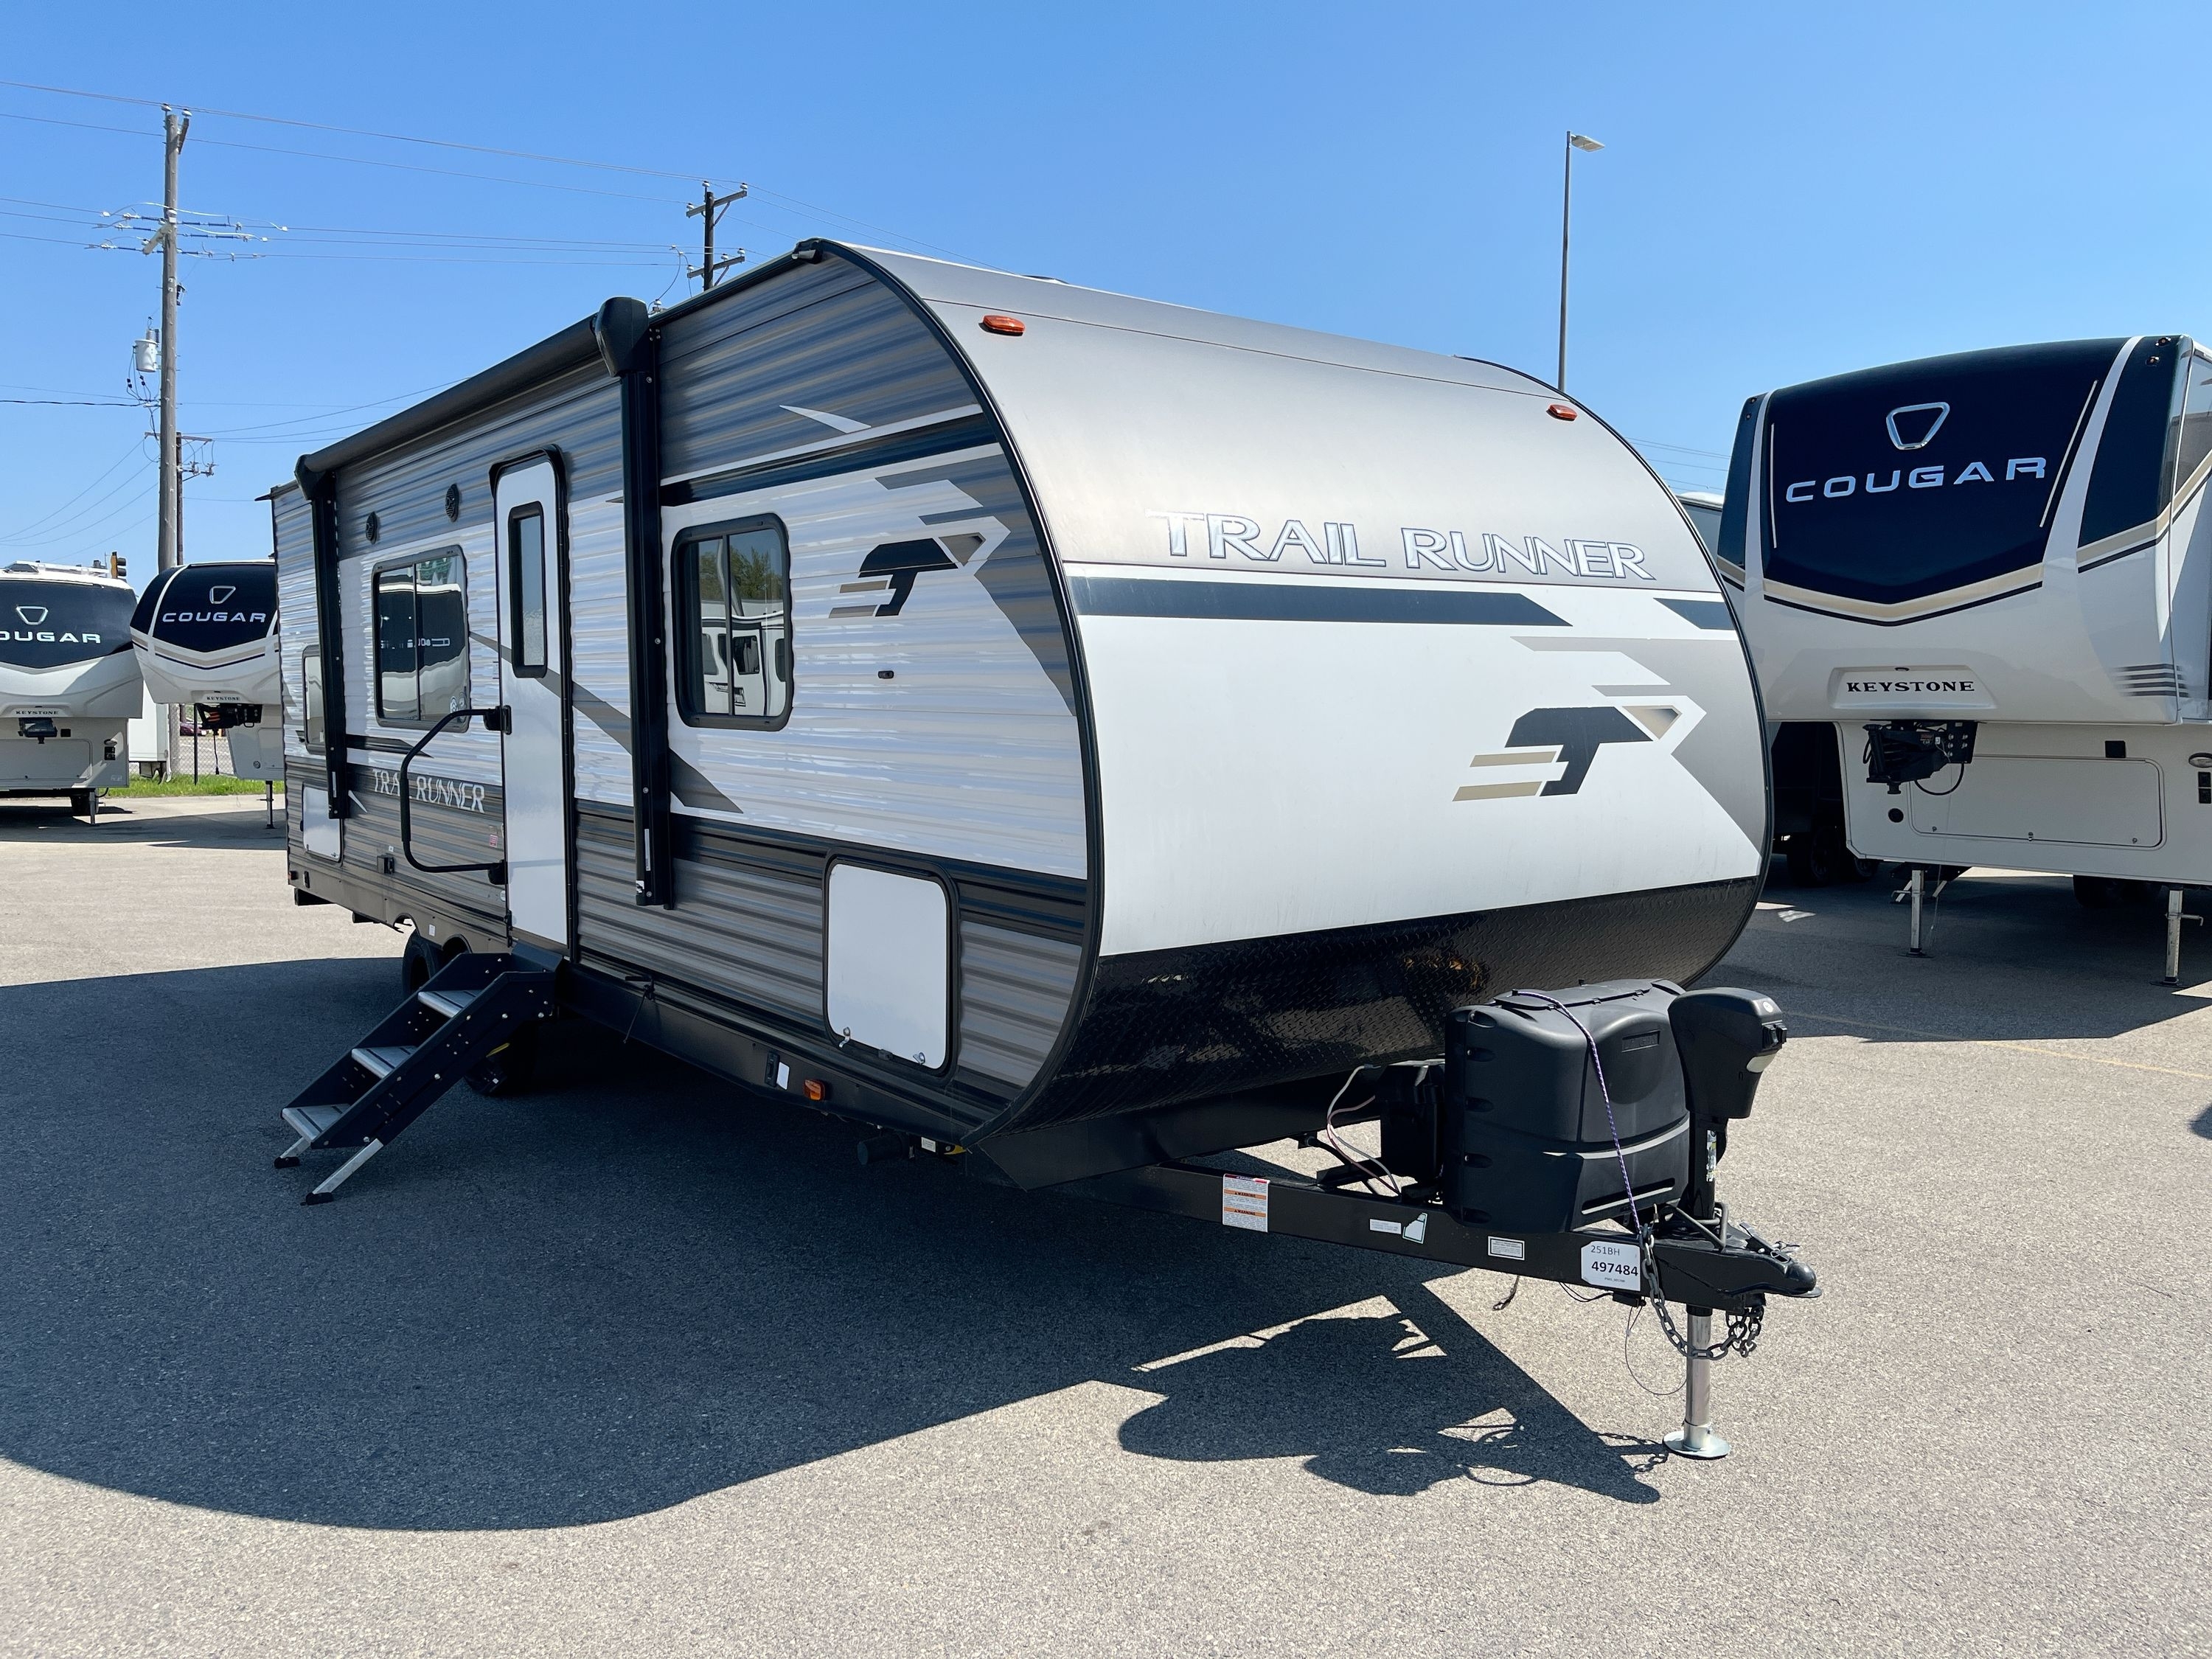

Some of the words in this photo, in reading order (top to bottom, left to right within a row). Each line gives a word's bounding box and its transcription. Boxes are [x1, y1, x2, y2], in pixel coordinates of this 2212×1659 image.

[1786, 456, 2046, 503] COUGAR
[1144, 509, 1387, 567] TRAIL
[1401, 527, 1656, 581] RUNNER
[162, 612, 266, 623] COUGAR
[1846, 681, 1975, 692] KEYSTONE
[416, 776, 485, 814] RUNNER
[1591, 1245, 1621, 1256] 251BH
[1591, 1261, 1638, 1276] 497484
